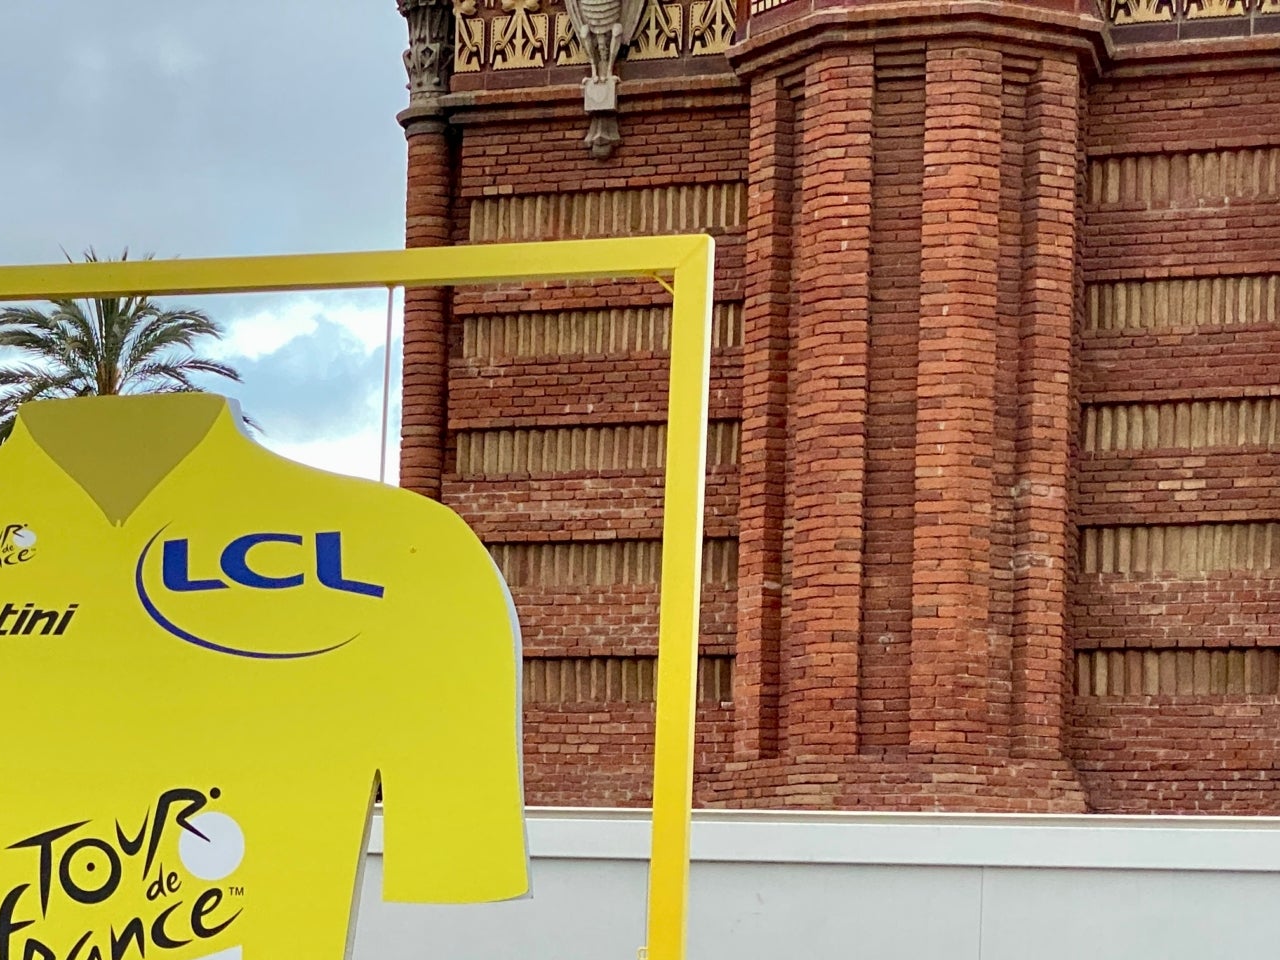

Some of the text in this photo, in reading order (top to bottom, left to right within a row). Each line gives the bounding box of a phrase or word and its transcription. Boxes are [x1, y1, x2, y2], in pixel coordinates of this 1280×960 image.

[2, 544, 14, 553] de
[162, 531, 384, 598] LCL
[146, 862, 182, 901] de
